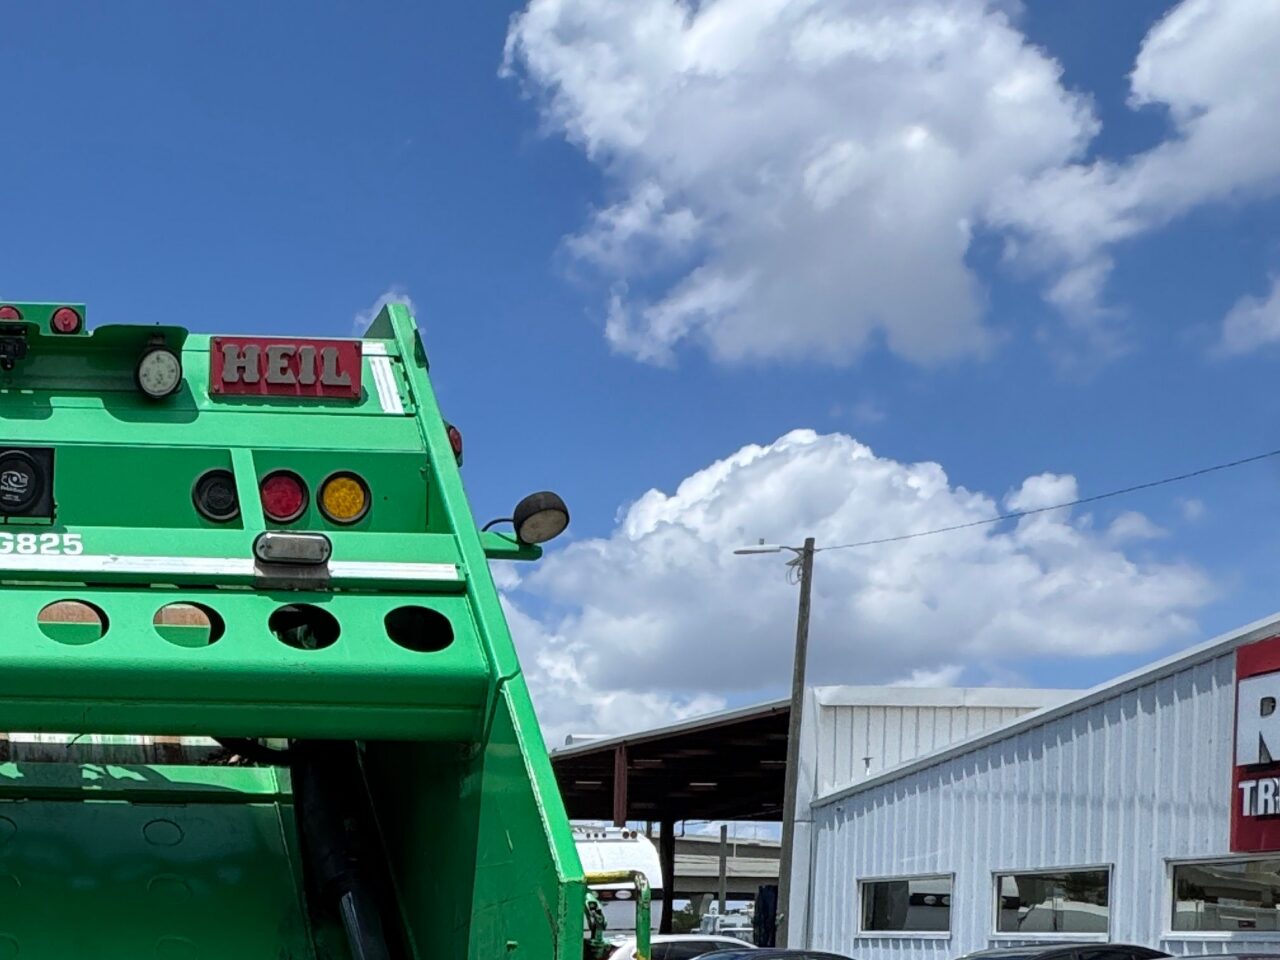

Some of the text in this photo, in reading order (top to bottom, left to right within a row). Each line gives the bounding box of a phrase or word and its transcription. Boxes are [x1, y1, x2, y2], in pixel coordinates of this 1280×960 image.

[222, 344, 352, 386] HEIL
[1236, 672, 1280, 766] R
[1237, 777, 1280, 817] TR
